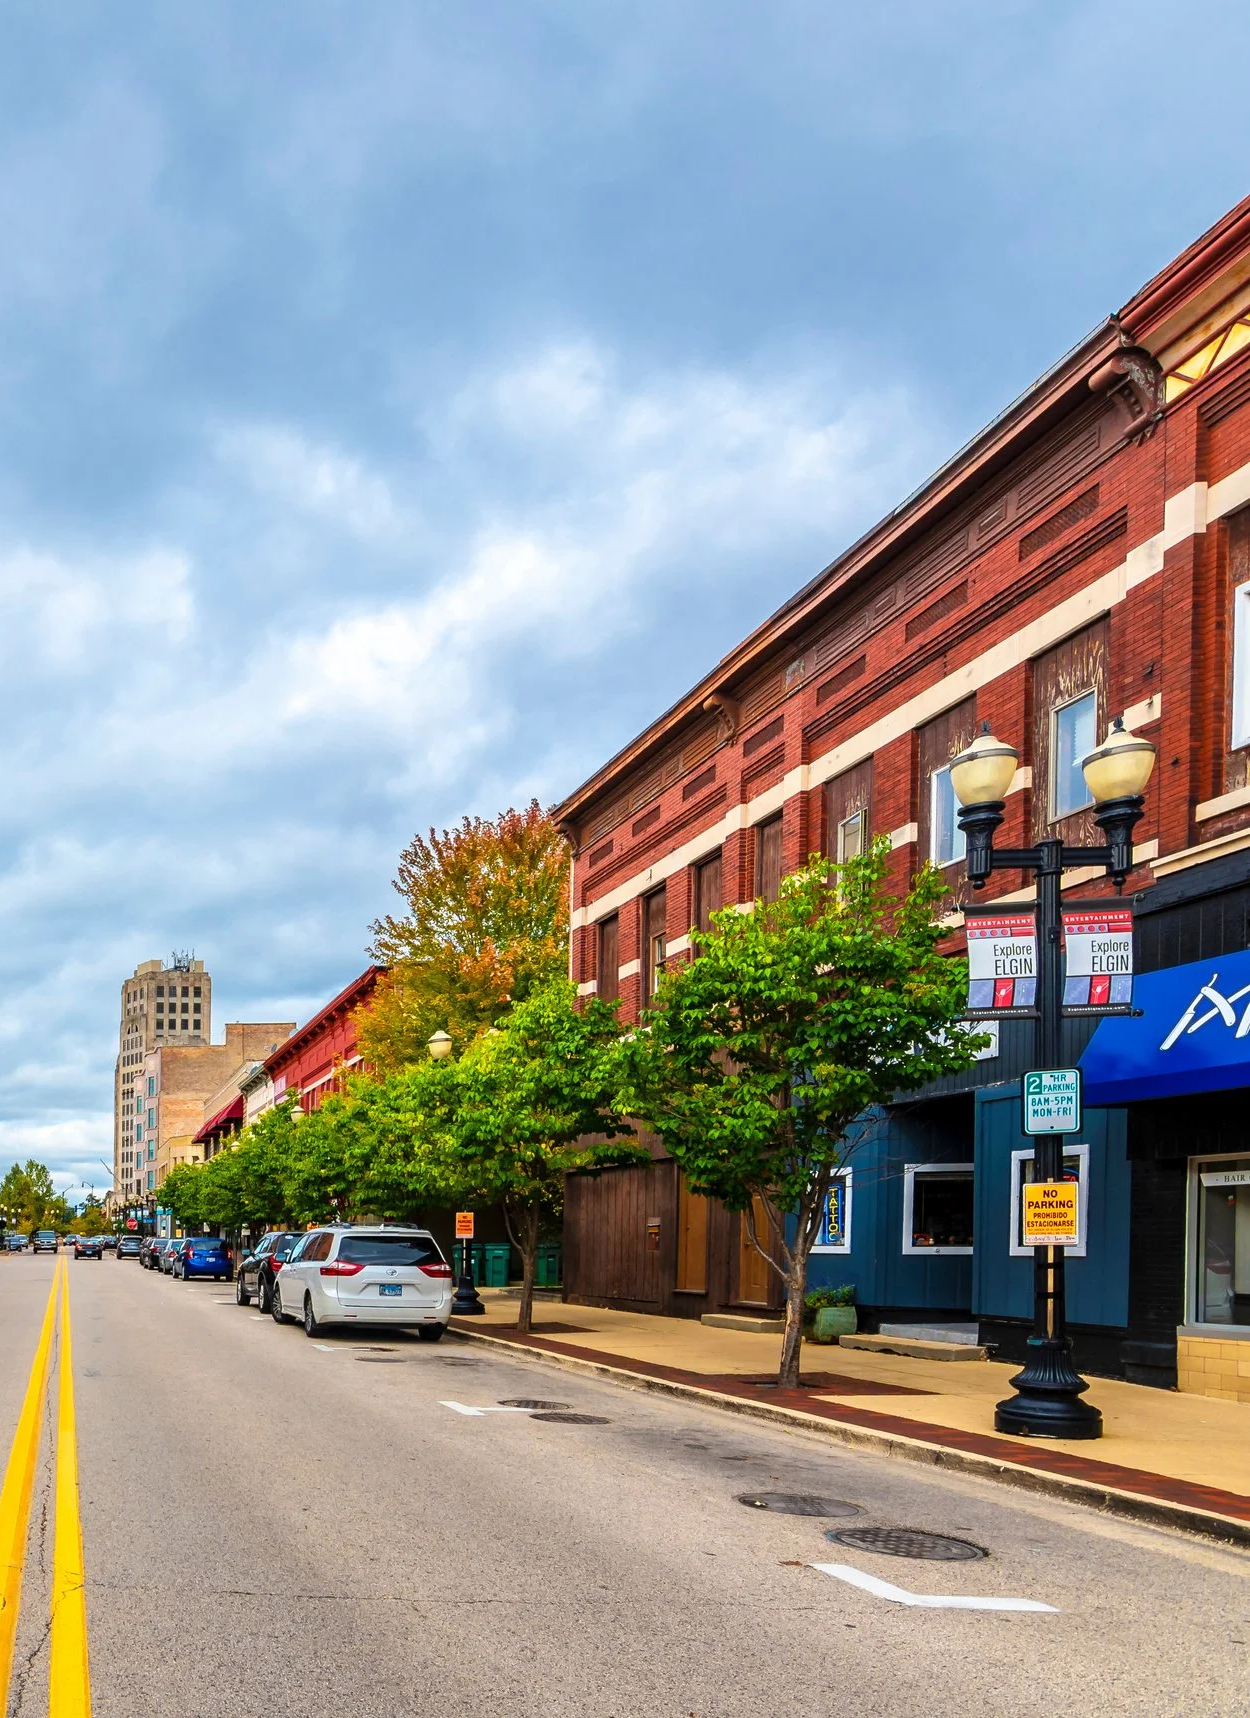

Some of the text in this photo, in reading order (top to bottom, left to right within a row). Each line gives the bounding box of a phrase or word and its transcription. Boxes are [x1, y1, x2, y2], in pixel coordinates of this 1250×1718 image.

[967, 918, 1031, 927] ENTERTAINMENT
[1065, 914, 1129, 922] ENTERTAINMENT
[993, 943, 1032, 959] Explore
[1091, 939, 1129, 955] Explore
[995, 958, 1033, 976] ELGIN
[1091, 954, 1129, 973] ELGIN
[1029, 1074, 1067, 1092] 2 HR
[1043, 1083, 1076, 1092] PARKING
[1031, 1096, 1073, 1107] 8AM-5PM
[1032, 1107, 1072, 1117] MON-FRI
[1224, 1174, 1246, 1182] HAIR
[1043, 1189, 1058, 1198] NO
[1027, 1200, 1074, 1209] PARKING
[1027, 1220, 1074, 1228] ESTACIONARSE
